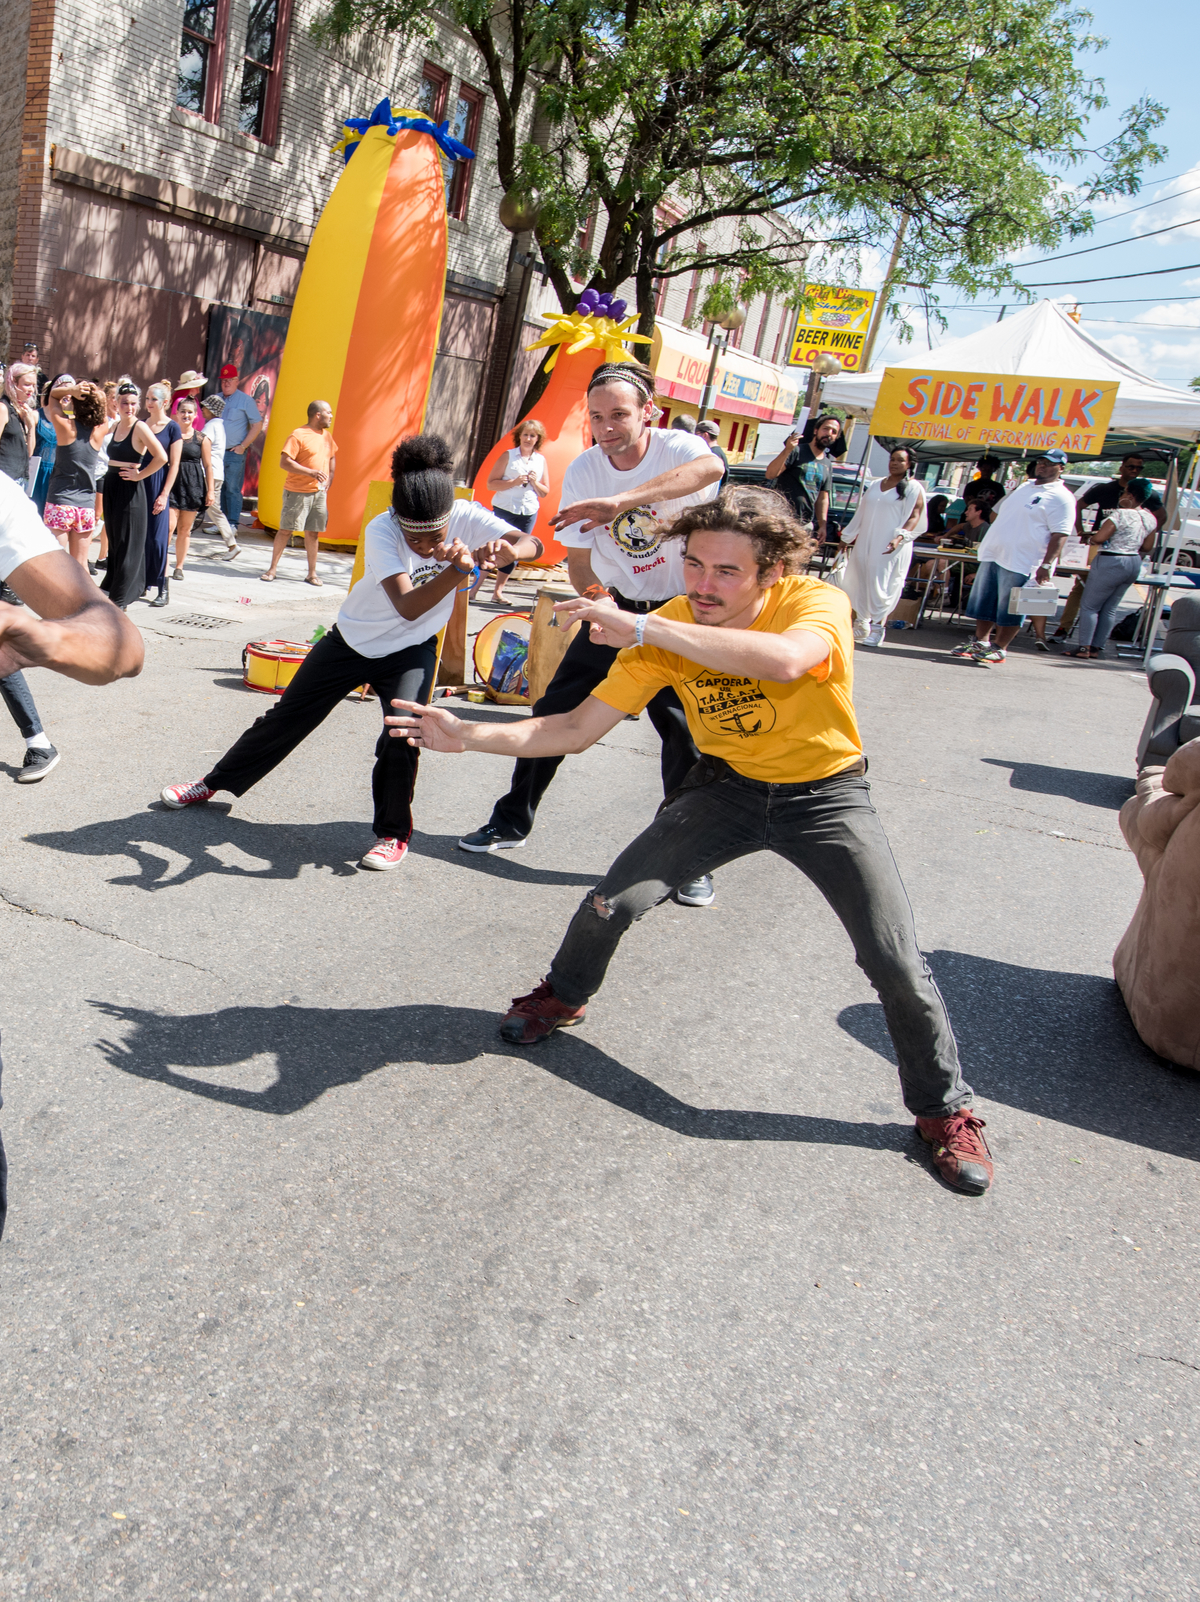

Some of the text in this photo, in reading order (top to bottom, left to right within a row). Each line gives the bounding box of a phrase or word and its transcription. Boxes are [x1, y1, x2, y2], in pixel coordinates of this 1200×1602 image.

[796, 328, 864, 350] BEER WINE
[898, 374, 1104, 429] SIDE WALK
[900, 420, 1098, 452] FESTIVAL OF PERFORMING ART
[626, 542, 661, 559] Saudade
[632, 555, 666, 574] Detroit
[702, 694, 761, 714] BRAZIL
